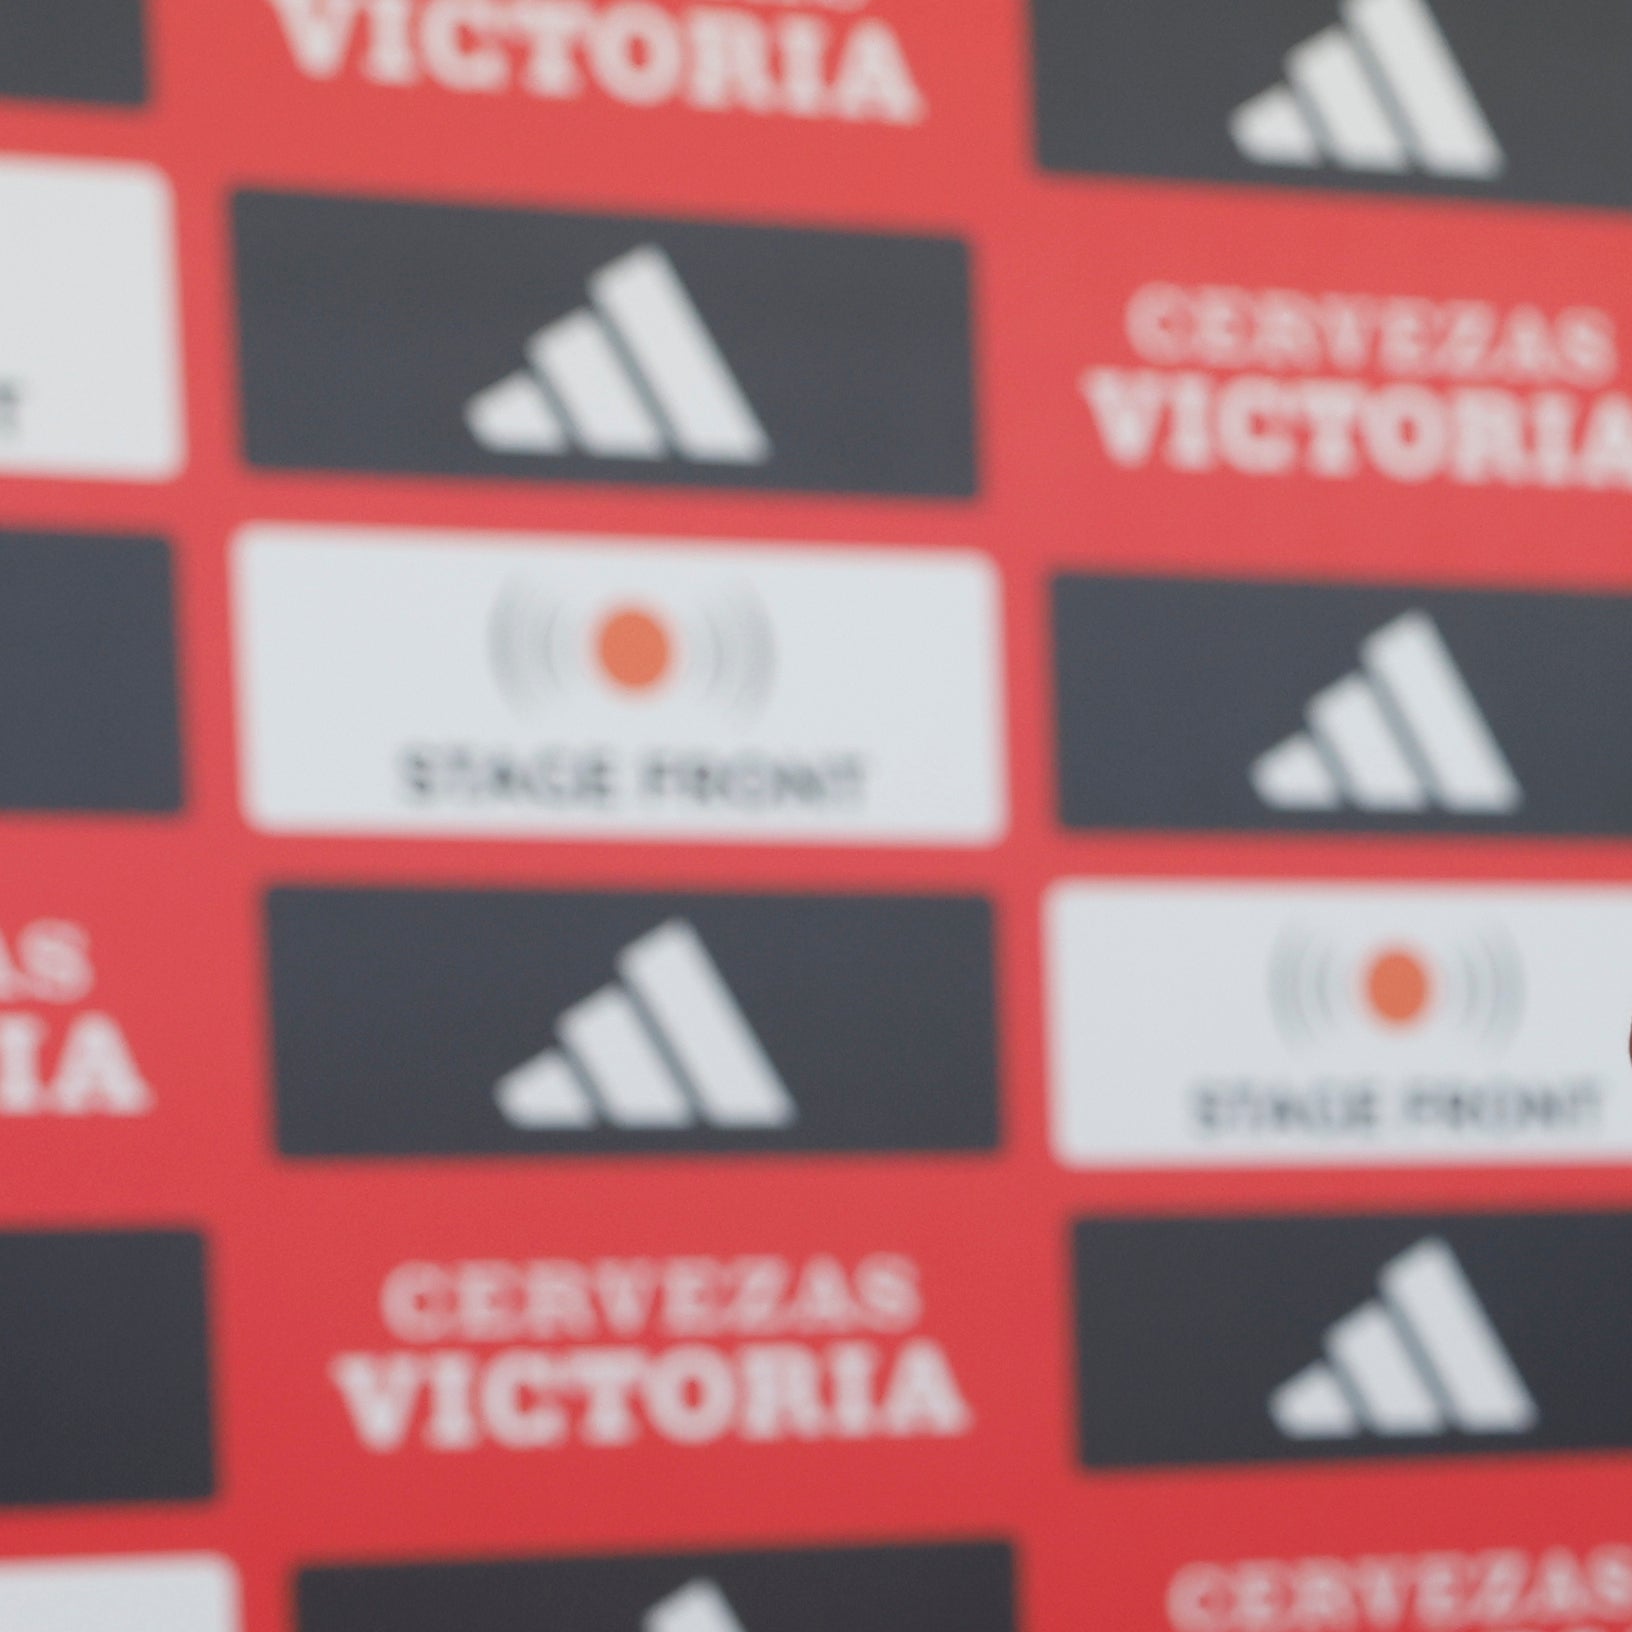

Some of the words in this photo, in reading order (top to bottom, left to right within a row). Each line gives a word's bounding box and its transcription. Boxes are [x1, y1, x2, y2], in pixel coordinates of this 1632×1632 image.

[268, 0, 924, 124] VICTORIA
[1127, 286, 1615, 384] CERVEZAS
[400, 746, 618, 810] STAGE
[638, 751, 865, 810] FRONT
[382, 1256, 920, 1340] CERVEZAS
[332, 1341, 972, 1453] VICTORIA
